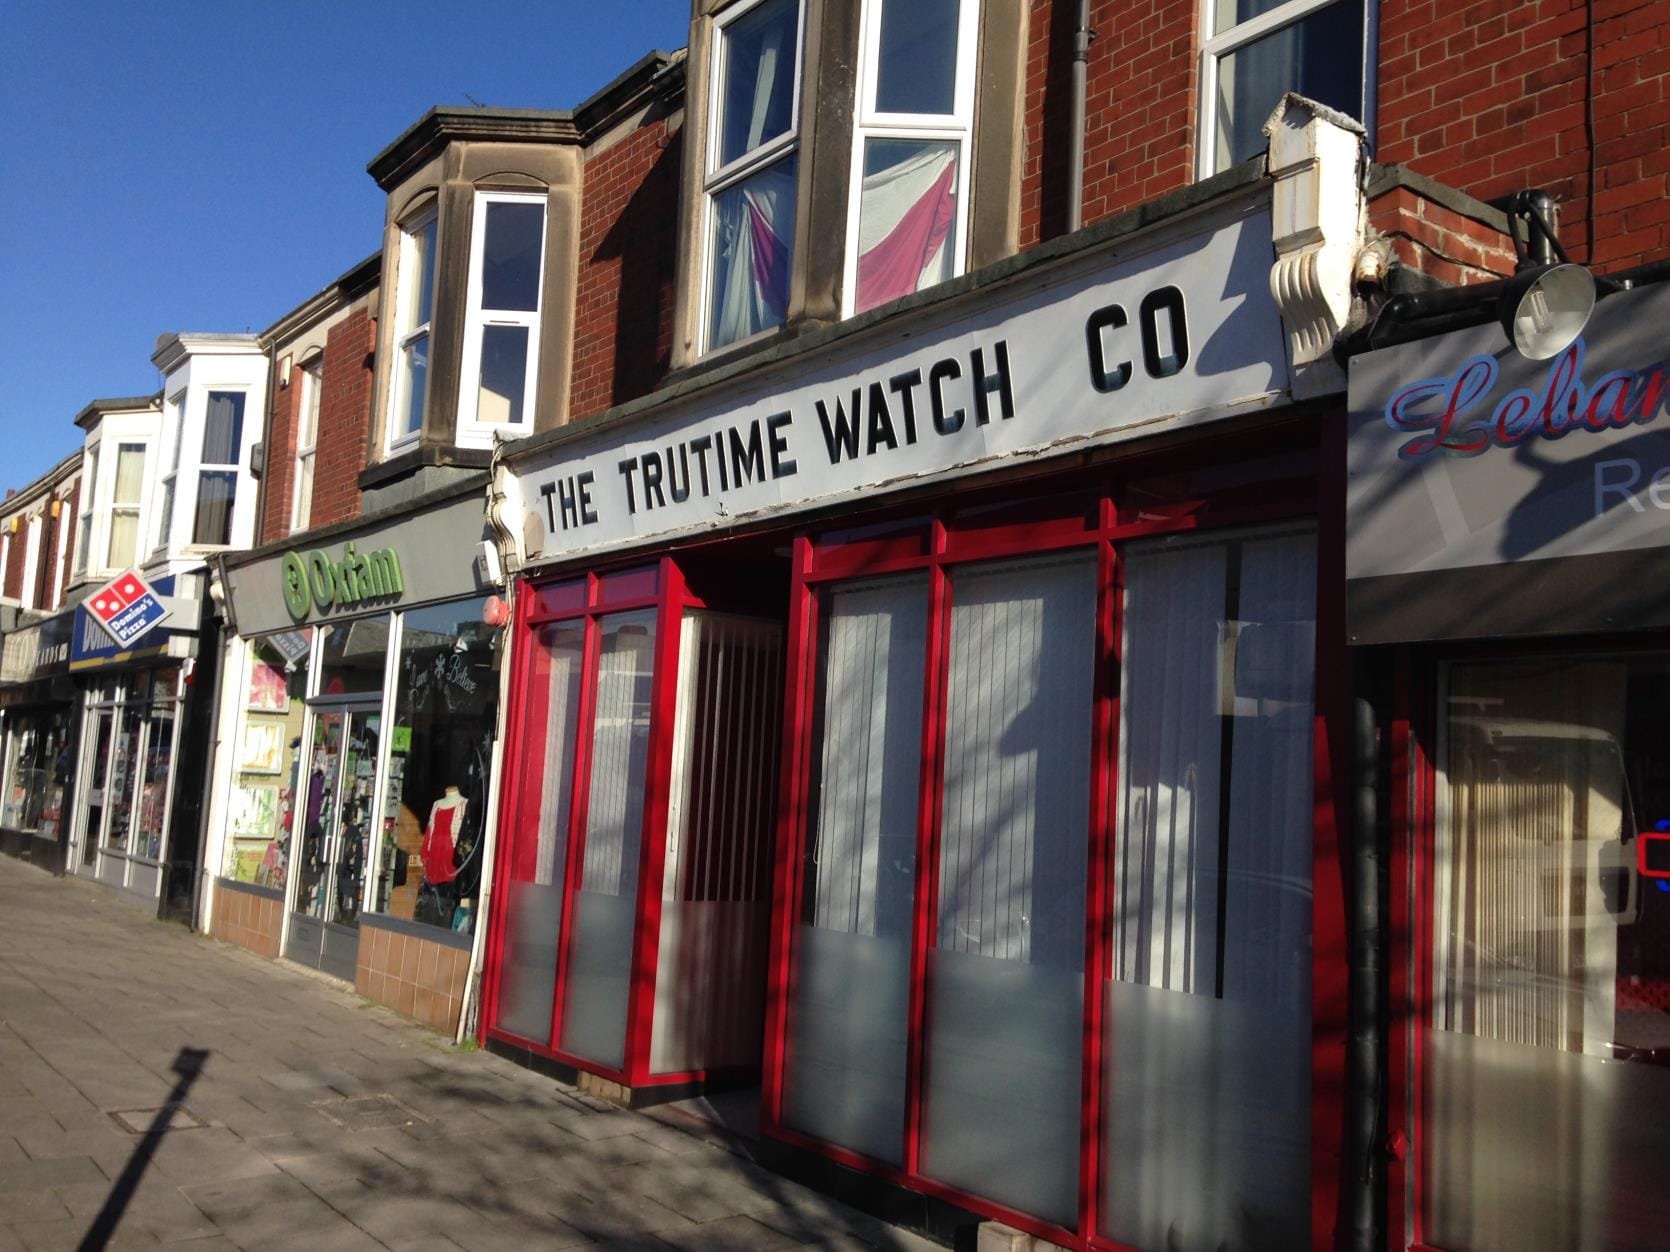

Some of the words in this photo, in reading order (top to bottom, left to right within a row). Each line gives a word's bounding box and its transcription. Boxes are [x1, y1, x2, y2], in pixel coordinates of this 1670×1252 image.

[540, 470, 600, 534] THE
[617, 409, 798, 516] TRUTIME
[815, 339, 1016, 465] WATCH
[1086, 284, 1190, 394] CO
[308, 542, 404, 607] Oxfam
[111, 597, 154, 632] Domino's
[119, 617, 148, 640] Pizza
